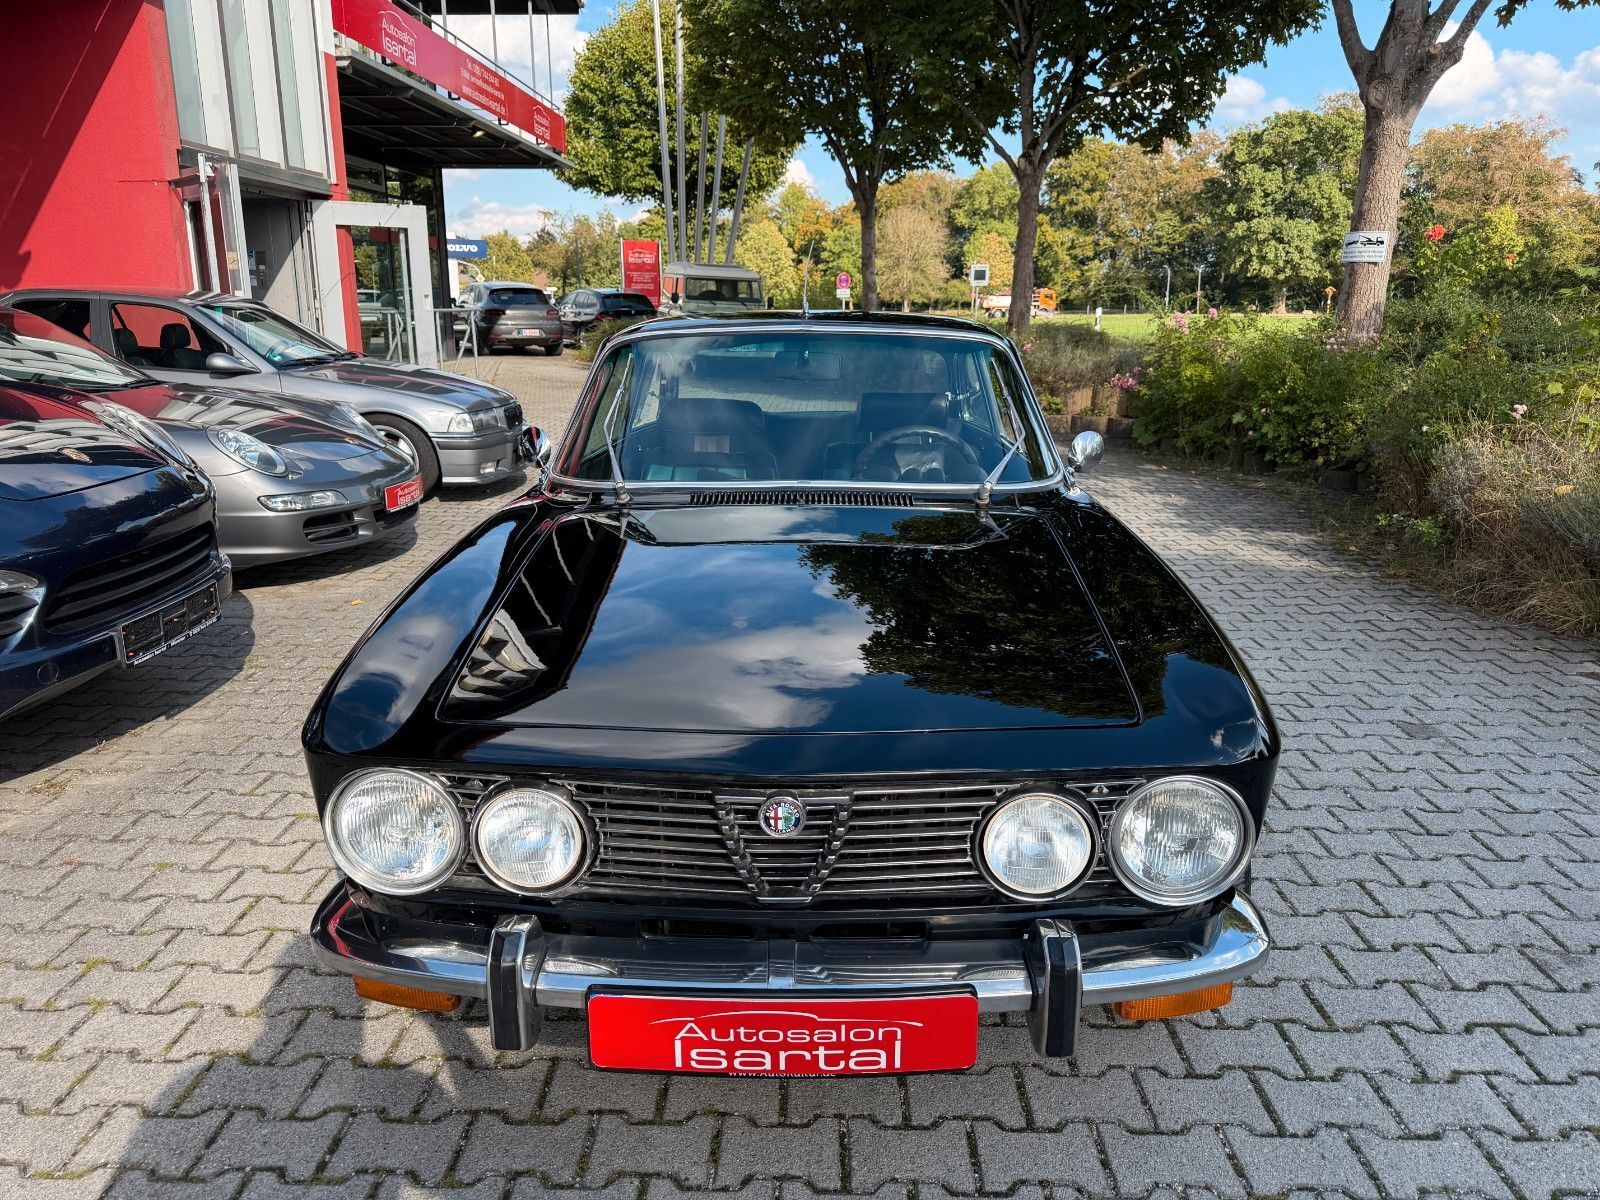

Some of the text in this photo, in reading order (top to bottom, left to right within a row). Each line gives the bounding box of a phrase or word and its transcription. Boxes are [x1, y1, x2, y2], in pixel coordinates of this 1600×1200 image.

[382, 17, 416, 47] Autosalon
[382, 30, 417, 66] Isartal
[447, 244, 478, 252] OLVO
[766, 803, 778, 817] ALFA
[675, 1022, 902, 1043] Autosalon
[674, 1039, 902, 1071] Isartal
